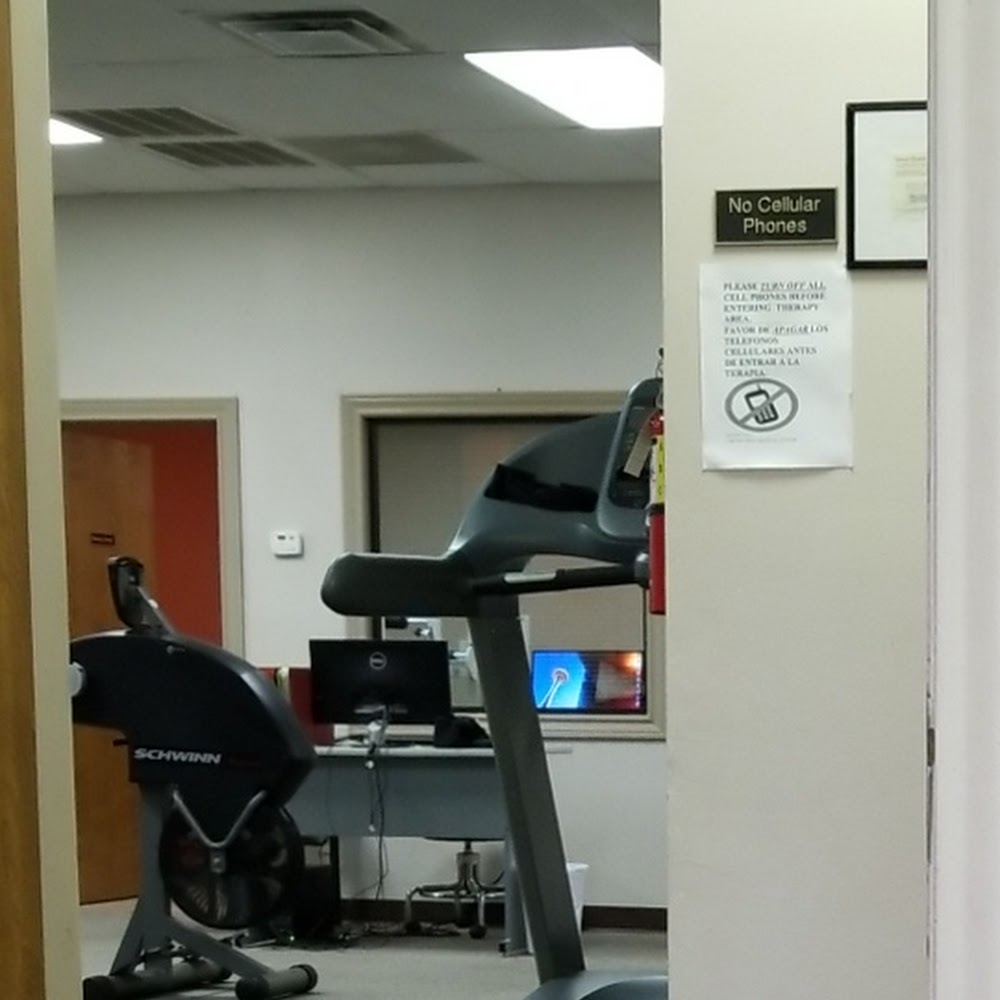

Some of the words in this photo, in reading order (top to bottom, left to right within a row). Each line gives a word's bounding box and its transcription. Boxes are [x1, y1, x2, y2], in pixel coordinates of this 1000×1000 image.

[728, 197, 753, 214] No
[757, 195, 821, 213] Cellular
[743, 217, 807, 234] Phones
[723, 282, 757, 291] PLEASE
[759, 281, 785, 292] TURN
[786, 281, 805, 291] OFF
[807, 281, 826, 290] ALL
[723, 293, 748, 301] CELL
[750, 293, 788, 301] PHONES
[788, 292, 825, 300] BEFORE
[723, 304, 771, 312] ENTERING
[776, 303, 819, 312] THERAPY
[724, 326, 756, 334] FAVOR
[772, 326, 810, 336] APAGAR
[810, 325, 829, 333] LOS
[724, 337, 779, 345] TELEFONOS
[724, 348, 785, 356] CELLULARES
[786, 347, 818, 355] ANTES
[725, 359, 737, 367] DE
[739, 358, 777, 366] ENTRAR
[787, 358, 800, 366] LA
[134, 748, 222, 765] SCHWINN
